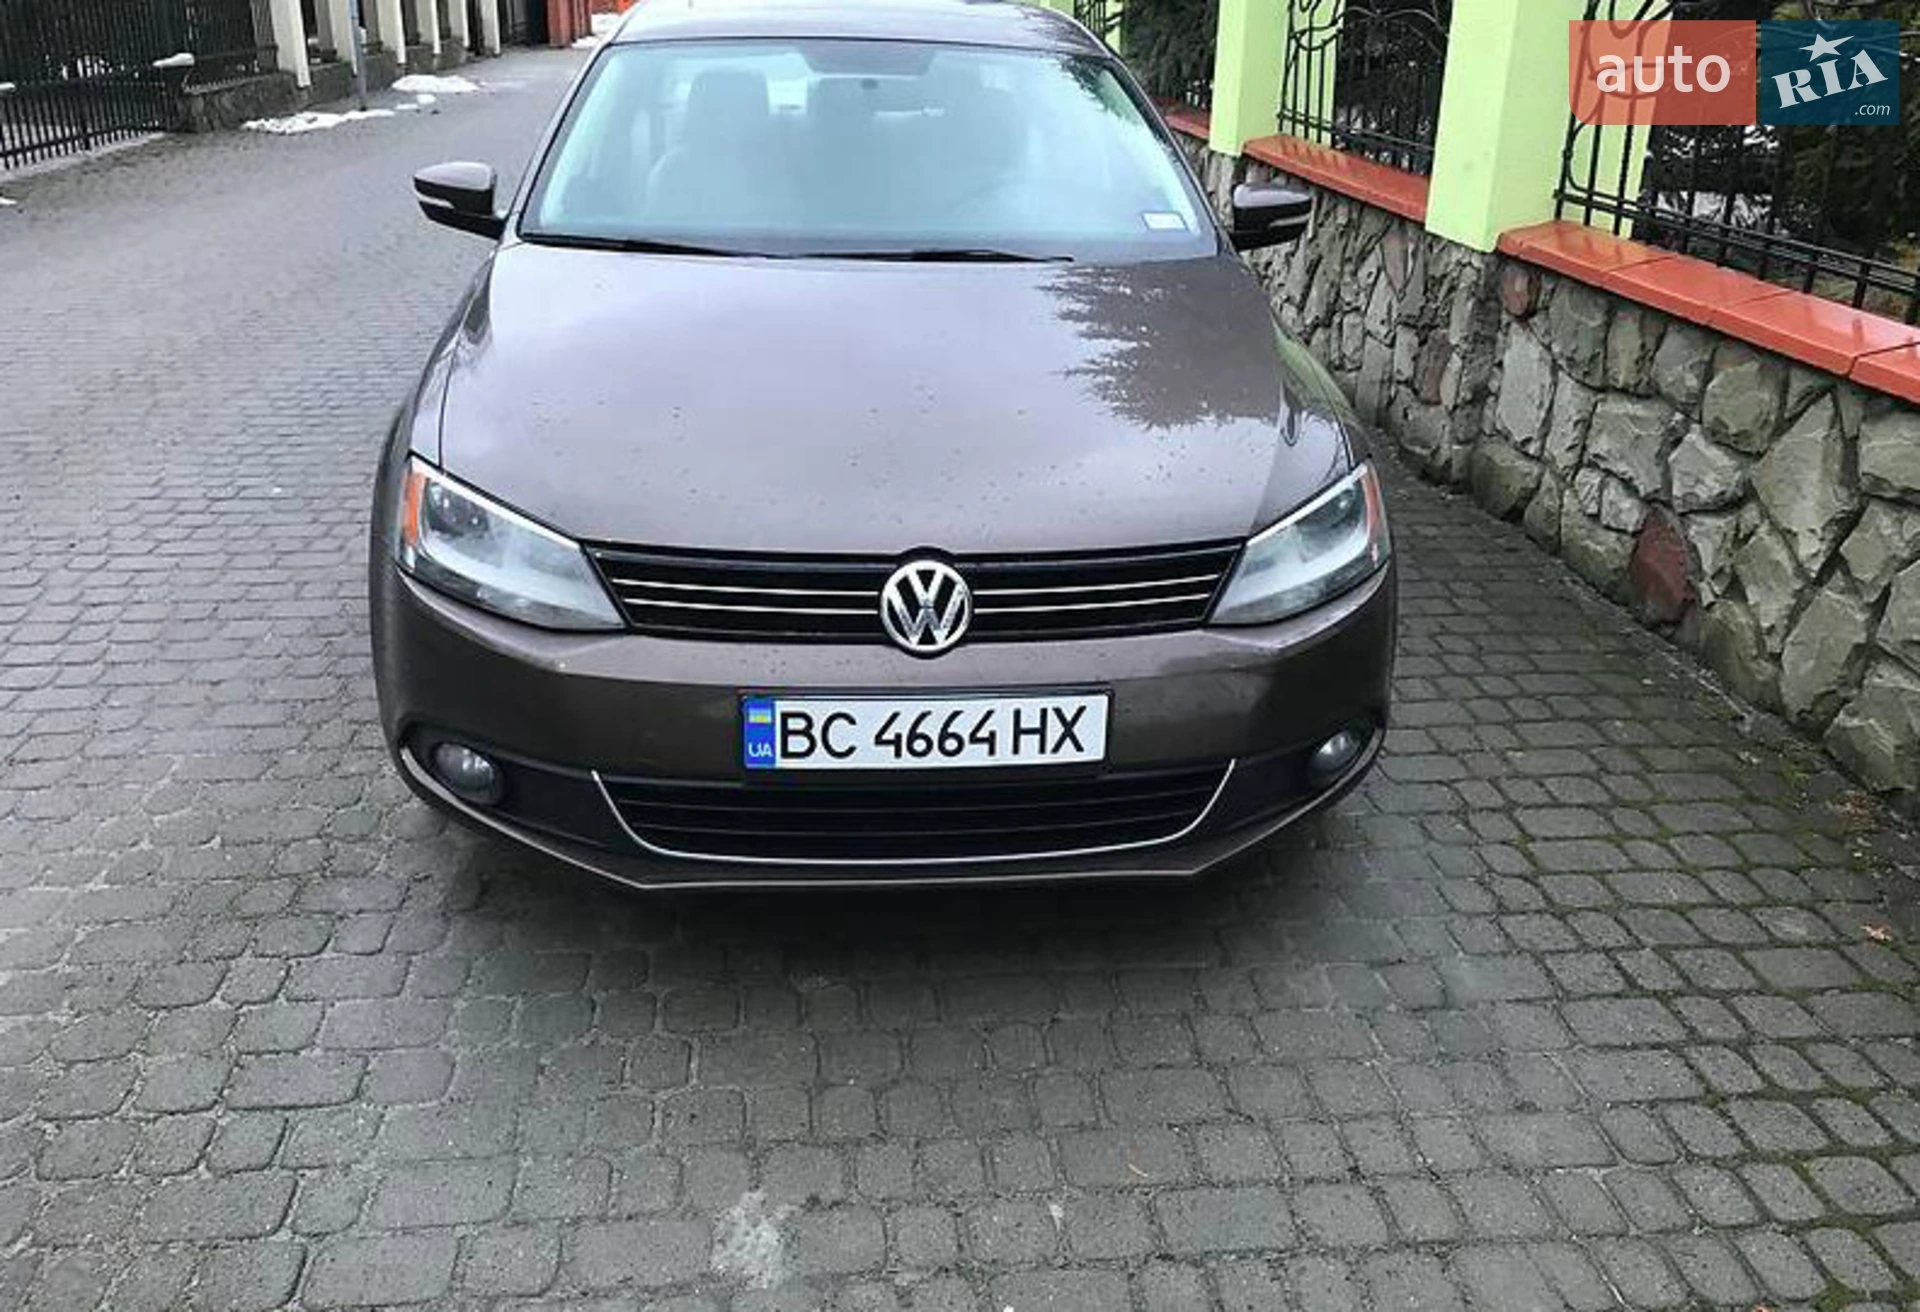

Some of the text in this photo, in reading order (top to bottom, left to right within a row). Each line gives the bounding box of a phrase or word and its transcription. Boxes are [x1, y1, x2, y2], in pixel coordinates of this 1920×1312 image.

[779, 705, 1087, 759] BC 4664 HX
[748, 742, 772, 757] UA
